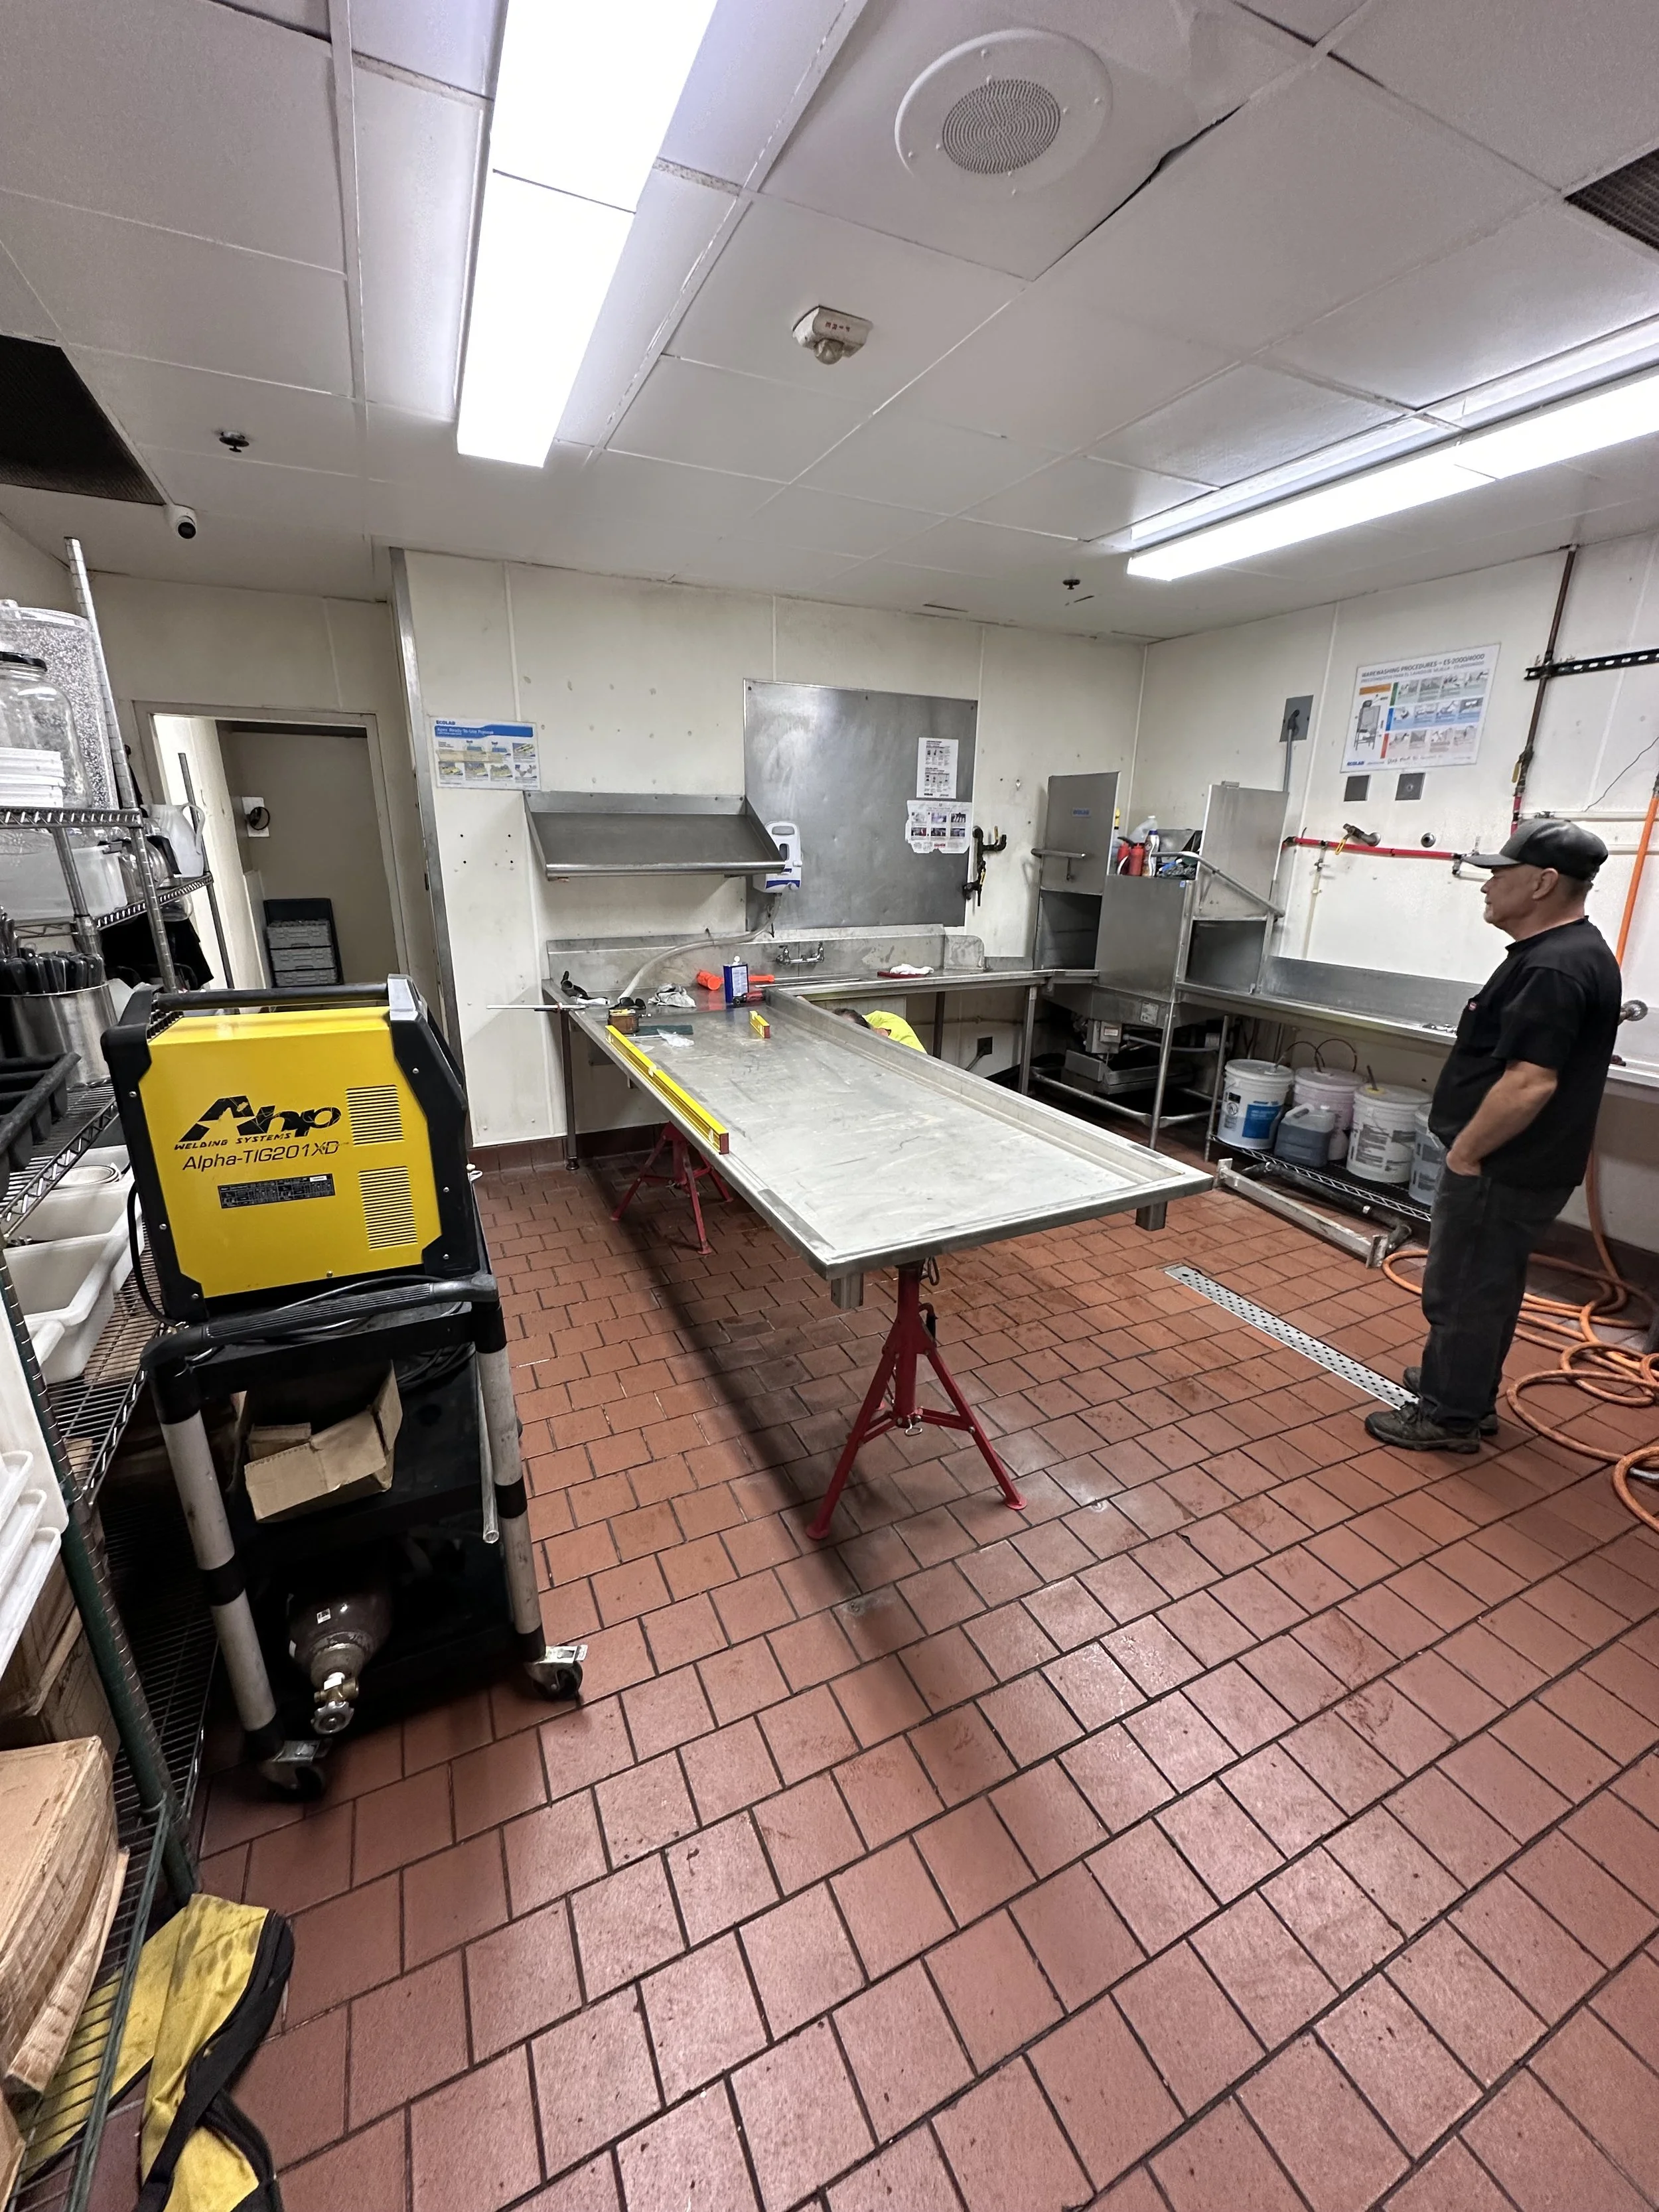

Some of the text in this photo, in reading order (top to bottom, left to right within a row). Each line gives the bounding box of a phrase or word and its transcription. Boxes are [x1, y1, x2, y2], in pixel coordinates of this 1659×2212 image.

[826, 322, 850, 332] FIRE
[1401, 660, 1437, 671] PROCEDURES
[175, 1133, 291, 1150] WELDING SYSTEMS
[182, 1141, 340, 1171] Alpha-TIG201XD
